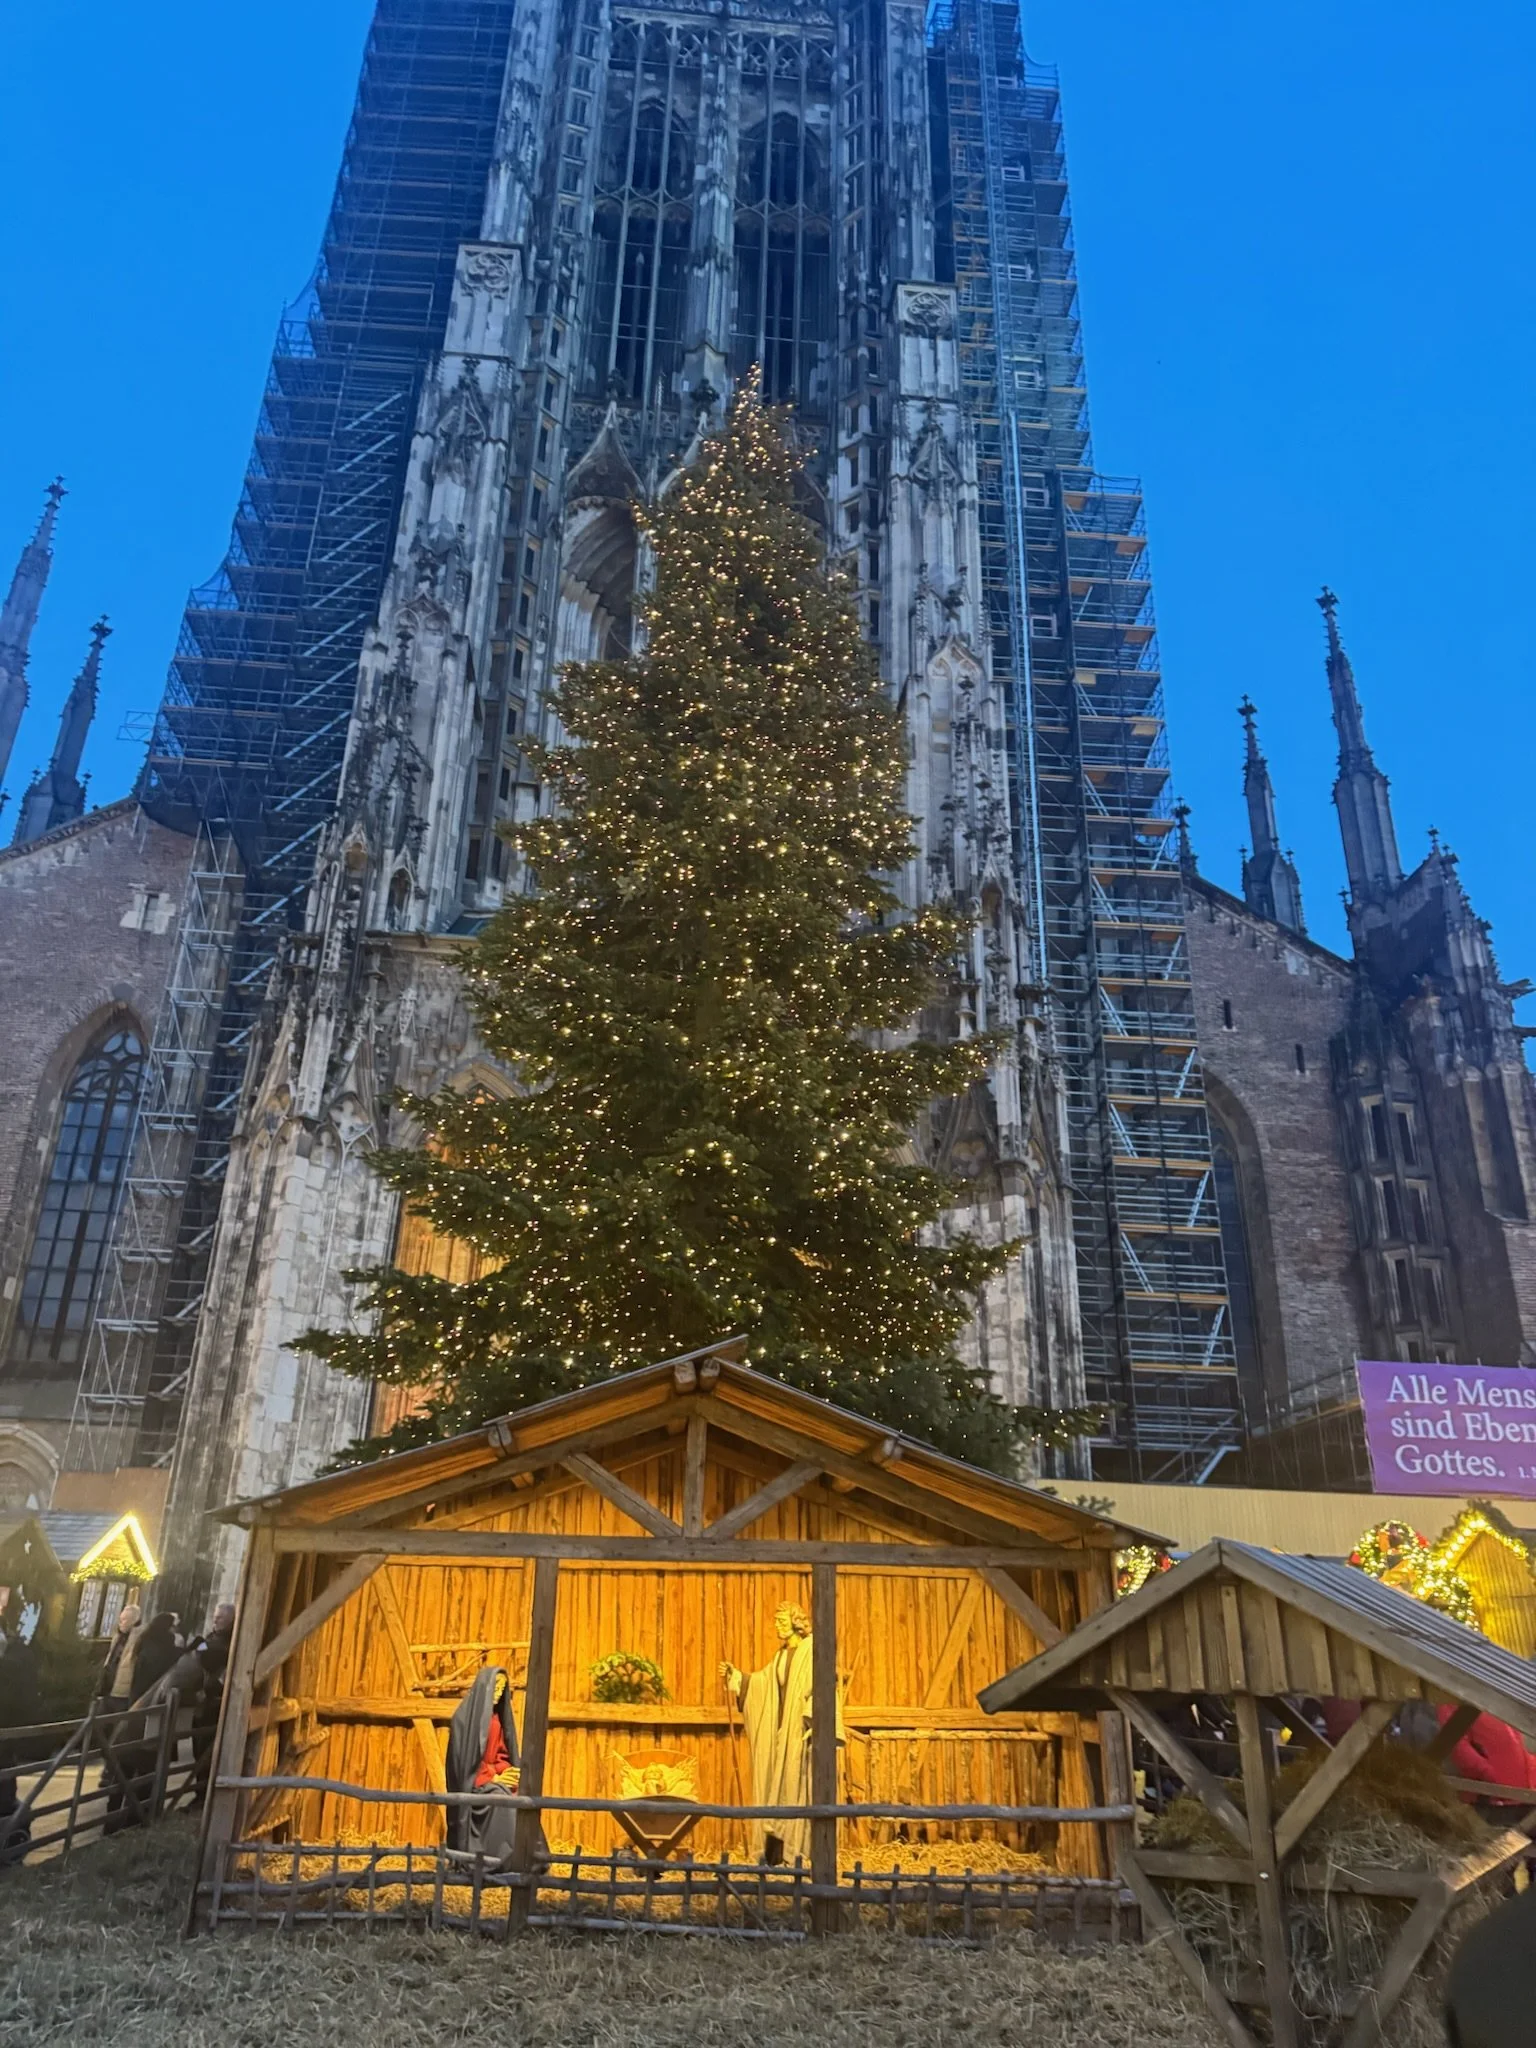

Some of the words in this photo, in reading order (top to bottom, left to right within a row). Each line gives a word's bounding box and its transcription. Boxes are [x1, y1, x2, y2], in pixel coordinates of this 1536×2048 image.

[1386, 1374, 1448, 1404] Alle
[1453, 1378, 1536, 1409] Mens
[1390, 1410, 1458, 1440] sind
[1461, 1411, 1536, 1443] Eben
[1395, 1444, 1506, 1477] Gottes.
